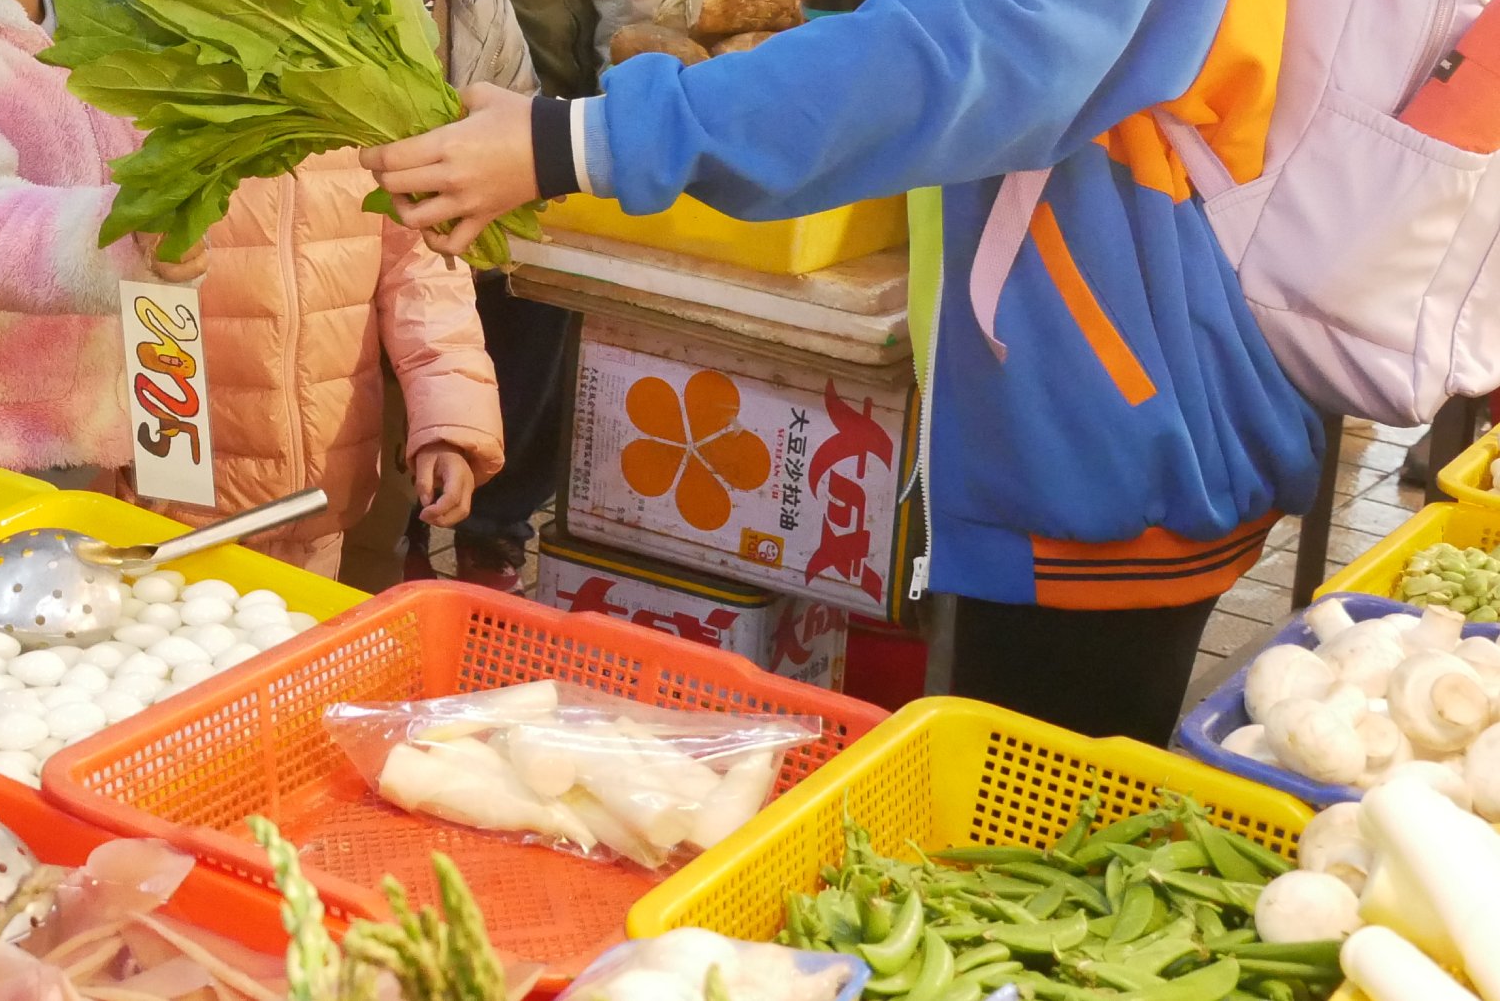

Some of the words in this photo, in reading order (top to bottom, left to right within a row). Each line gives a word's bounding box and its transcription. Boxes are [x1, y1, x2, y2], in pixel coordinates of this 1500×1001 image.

[780, 407, 810, 532] 大豆沙拉油
